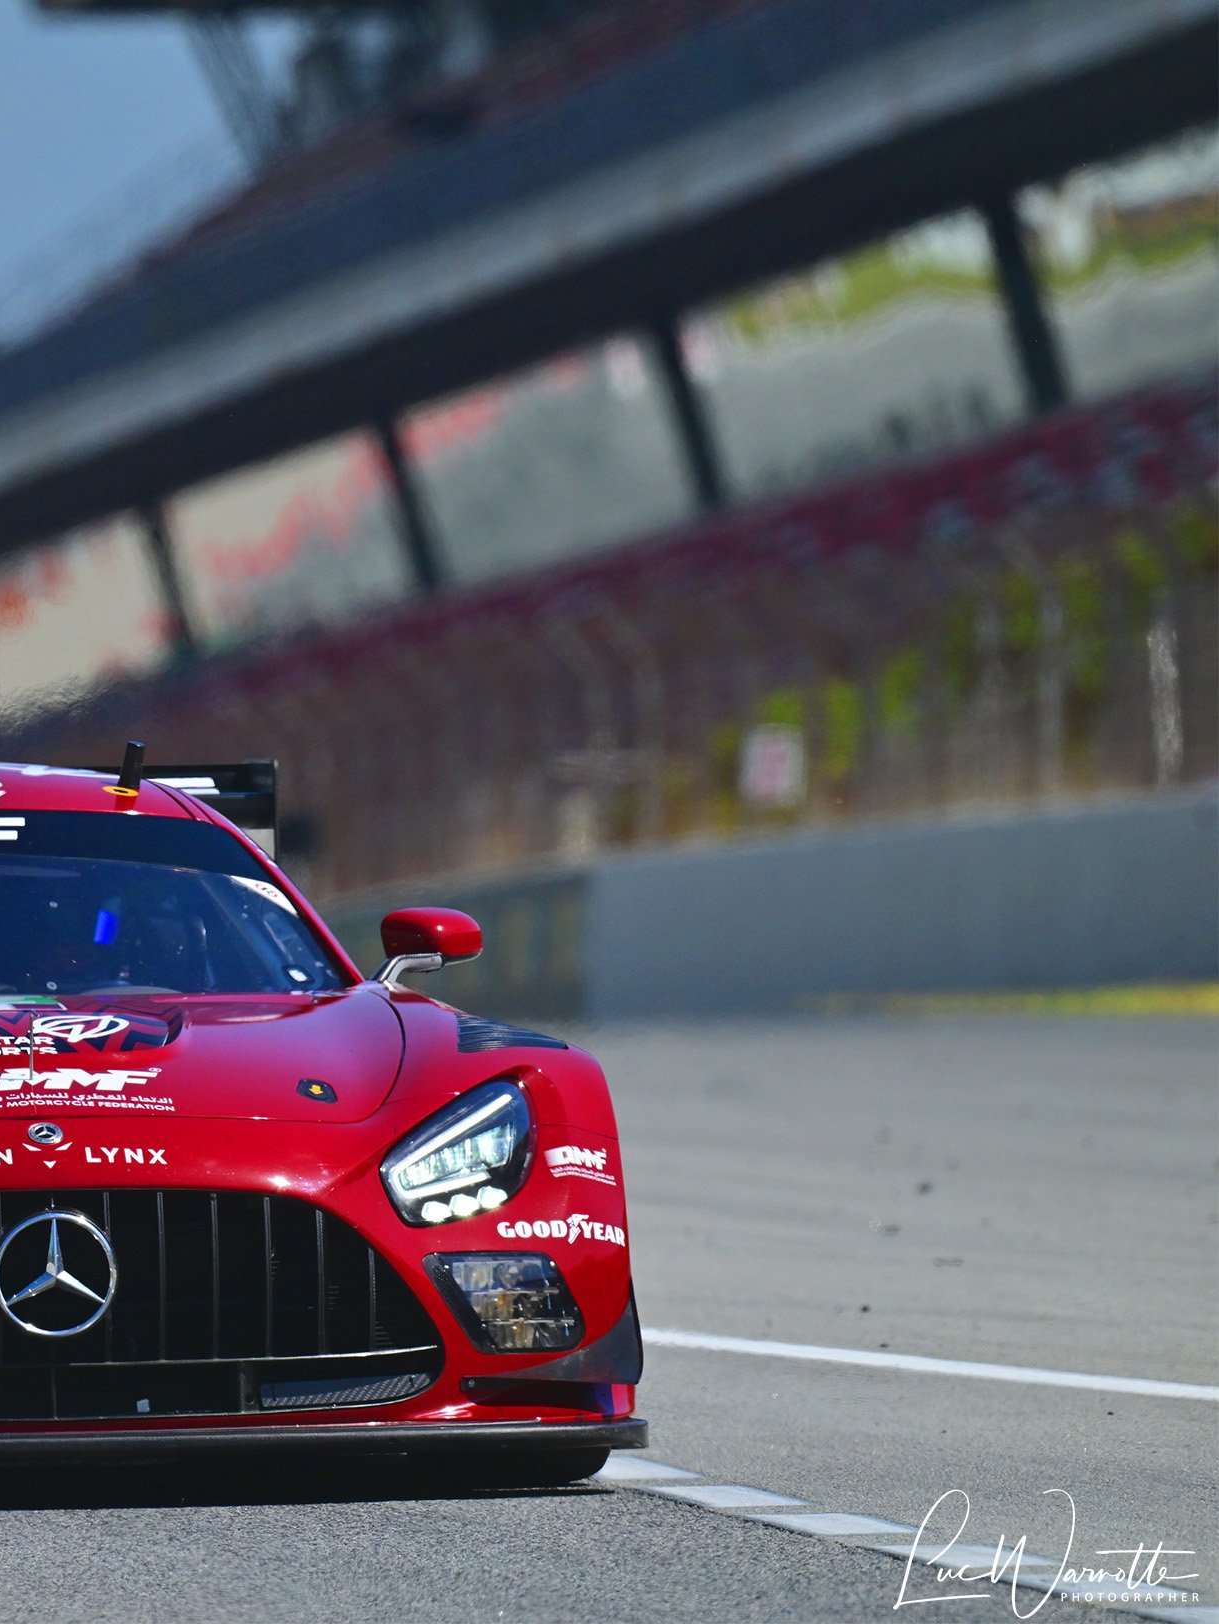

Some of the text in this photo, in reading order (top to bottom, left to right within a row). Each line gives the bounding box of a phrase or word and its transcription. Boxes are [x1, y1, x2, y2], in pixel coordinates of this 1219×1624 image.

[6, 1100, 95, 1108] MOTORCYCLE
[97, 1101, 176, 1112] FEDERATION
[85, 1146, 168, 1165] LYNX
[497, 1214, 626, 1247] GOODYEAR
